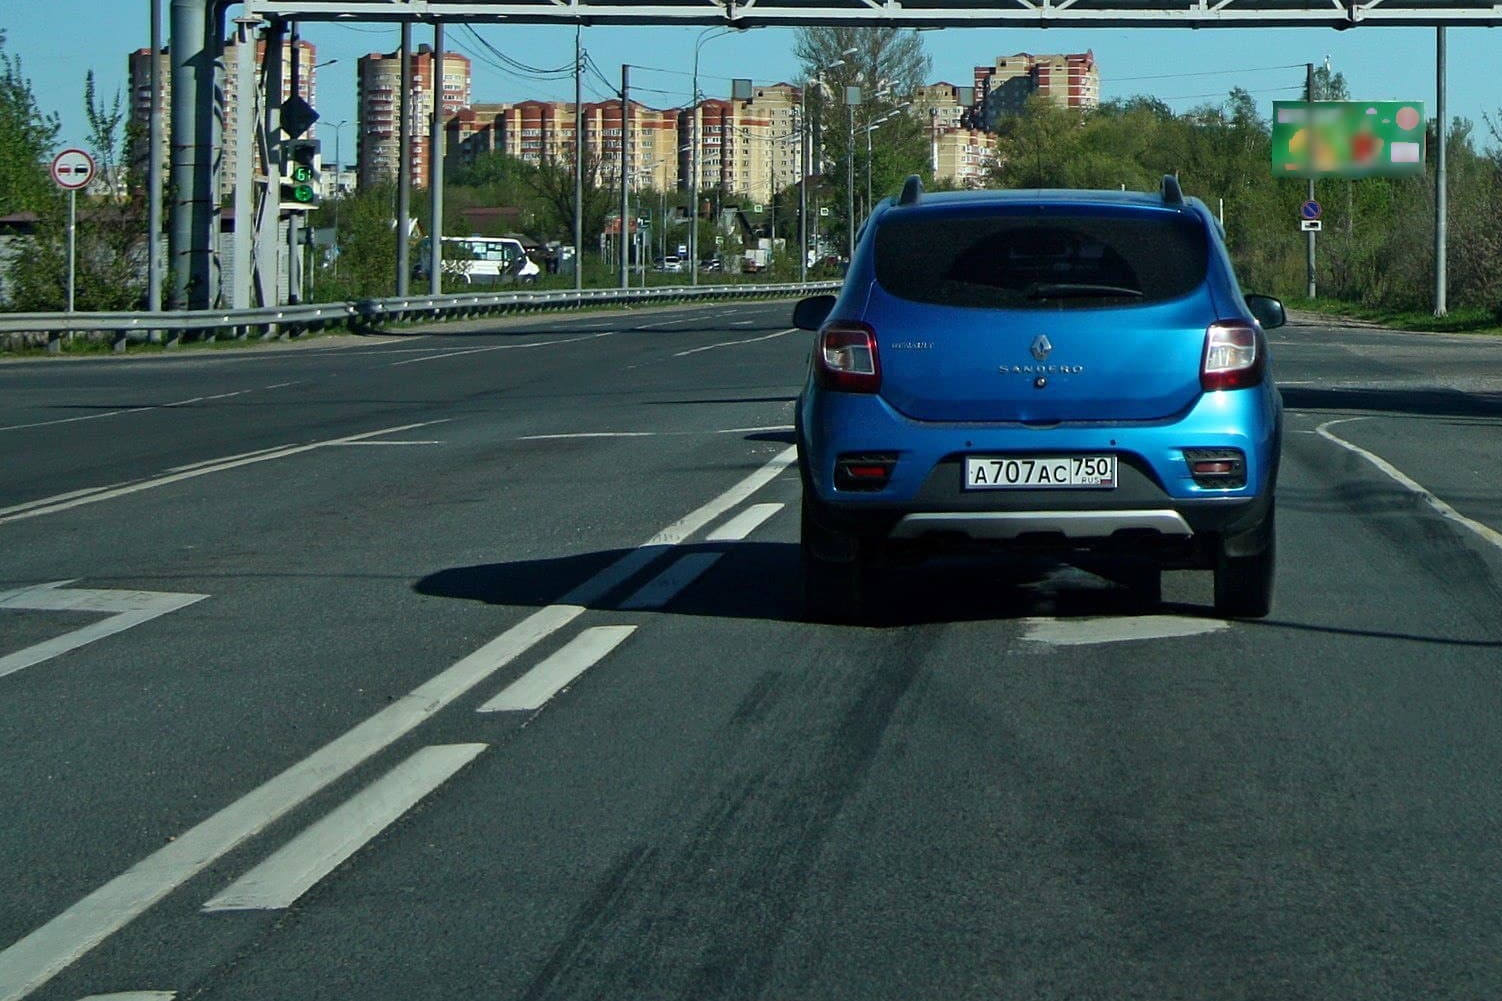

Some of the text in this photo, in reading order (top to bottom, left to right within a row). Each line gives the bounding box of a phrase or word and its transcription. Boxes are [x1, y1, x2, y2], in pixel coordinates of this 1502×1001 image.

[974, 459, 1108, 484] А707АС 750
[1081, 476, 1101, 485] RUS
